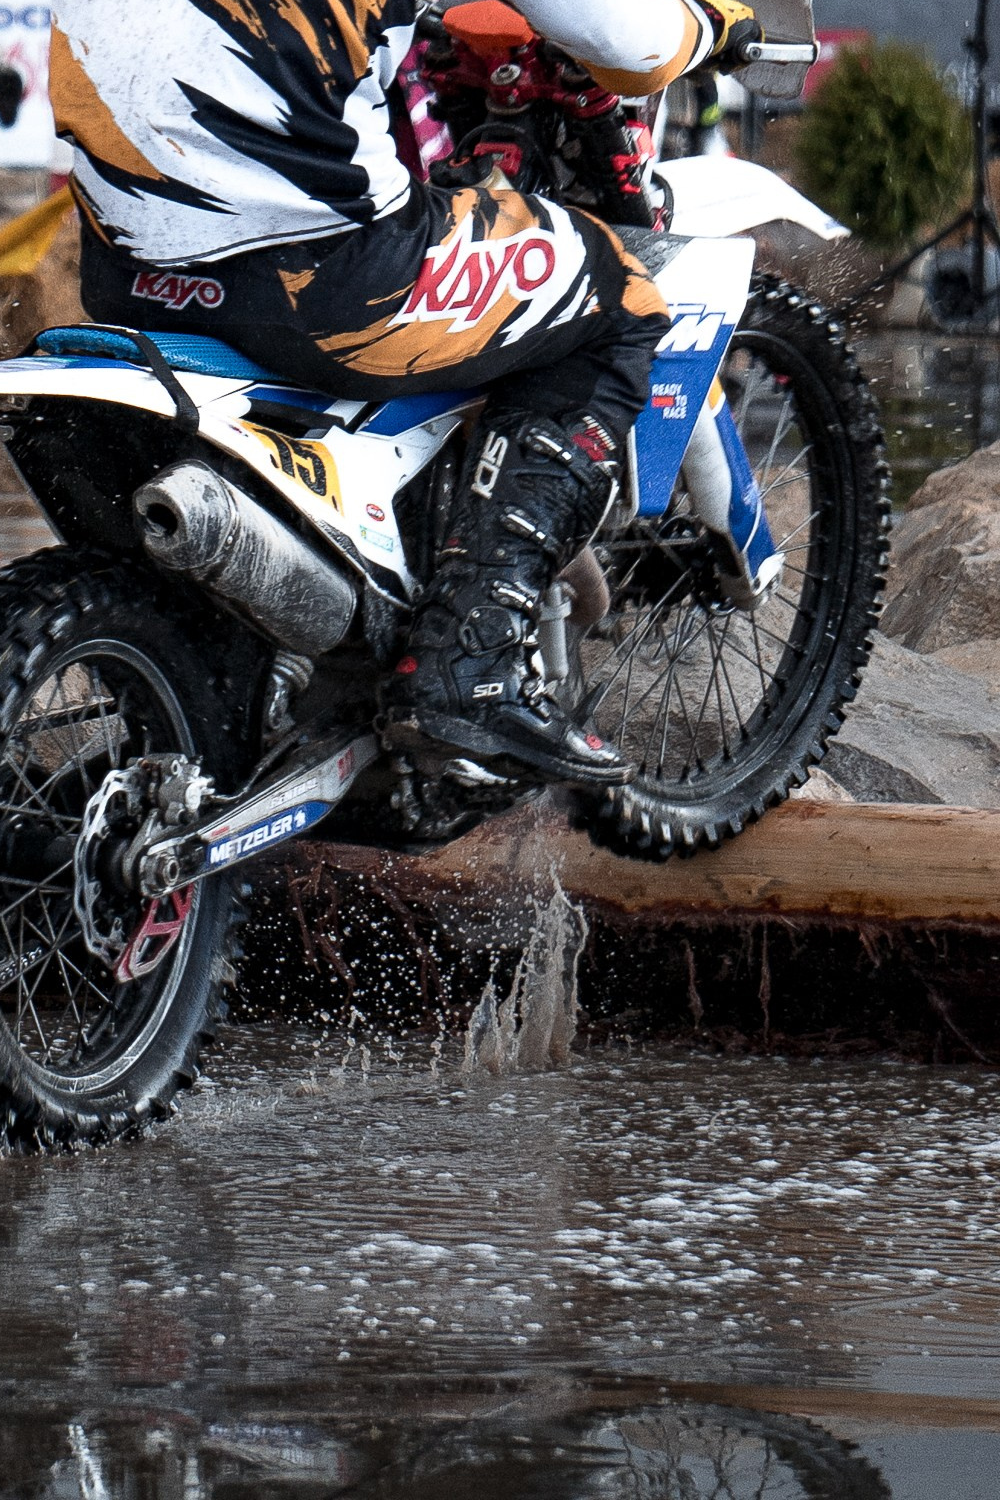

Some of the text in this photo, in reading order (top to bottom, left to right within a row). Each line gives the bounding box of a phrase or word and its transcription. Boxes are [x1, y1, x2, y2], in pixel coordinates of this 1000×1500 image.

[131, 272, 225, 310] KAYO
[404, 236, 556, 322] KAYO
[651, 383, 682, 396] READY
[675, 395, 688, 407] TO
[662, 407, 687, 419] RACE
[209, 813, 293, 864] METZELER
